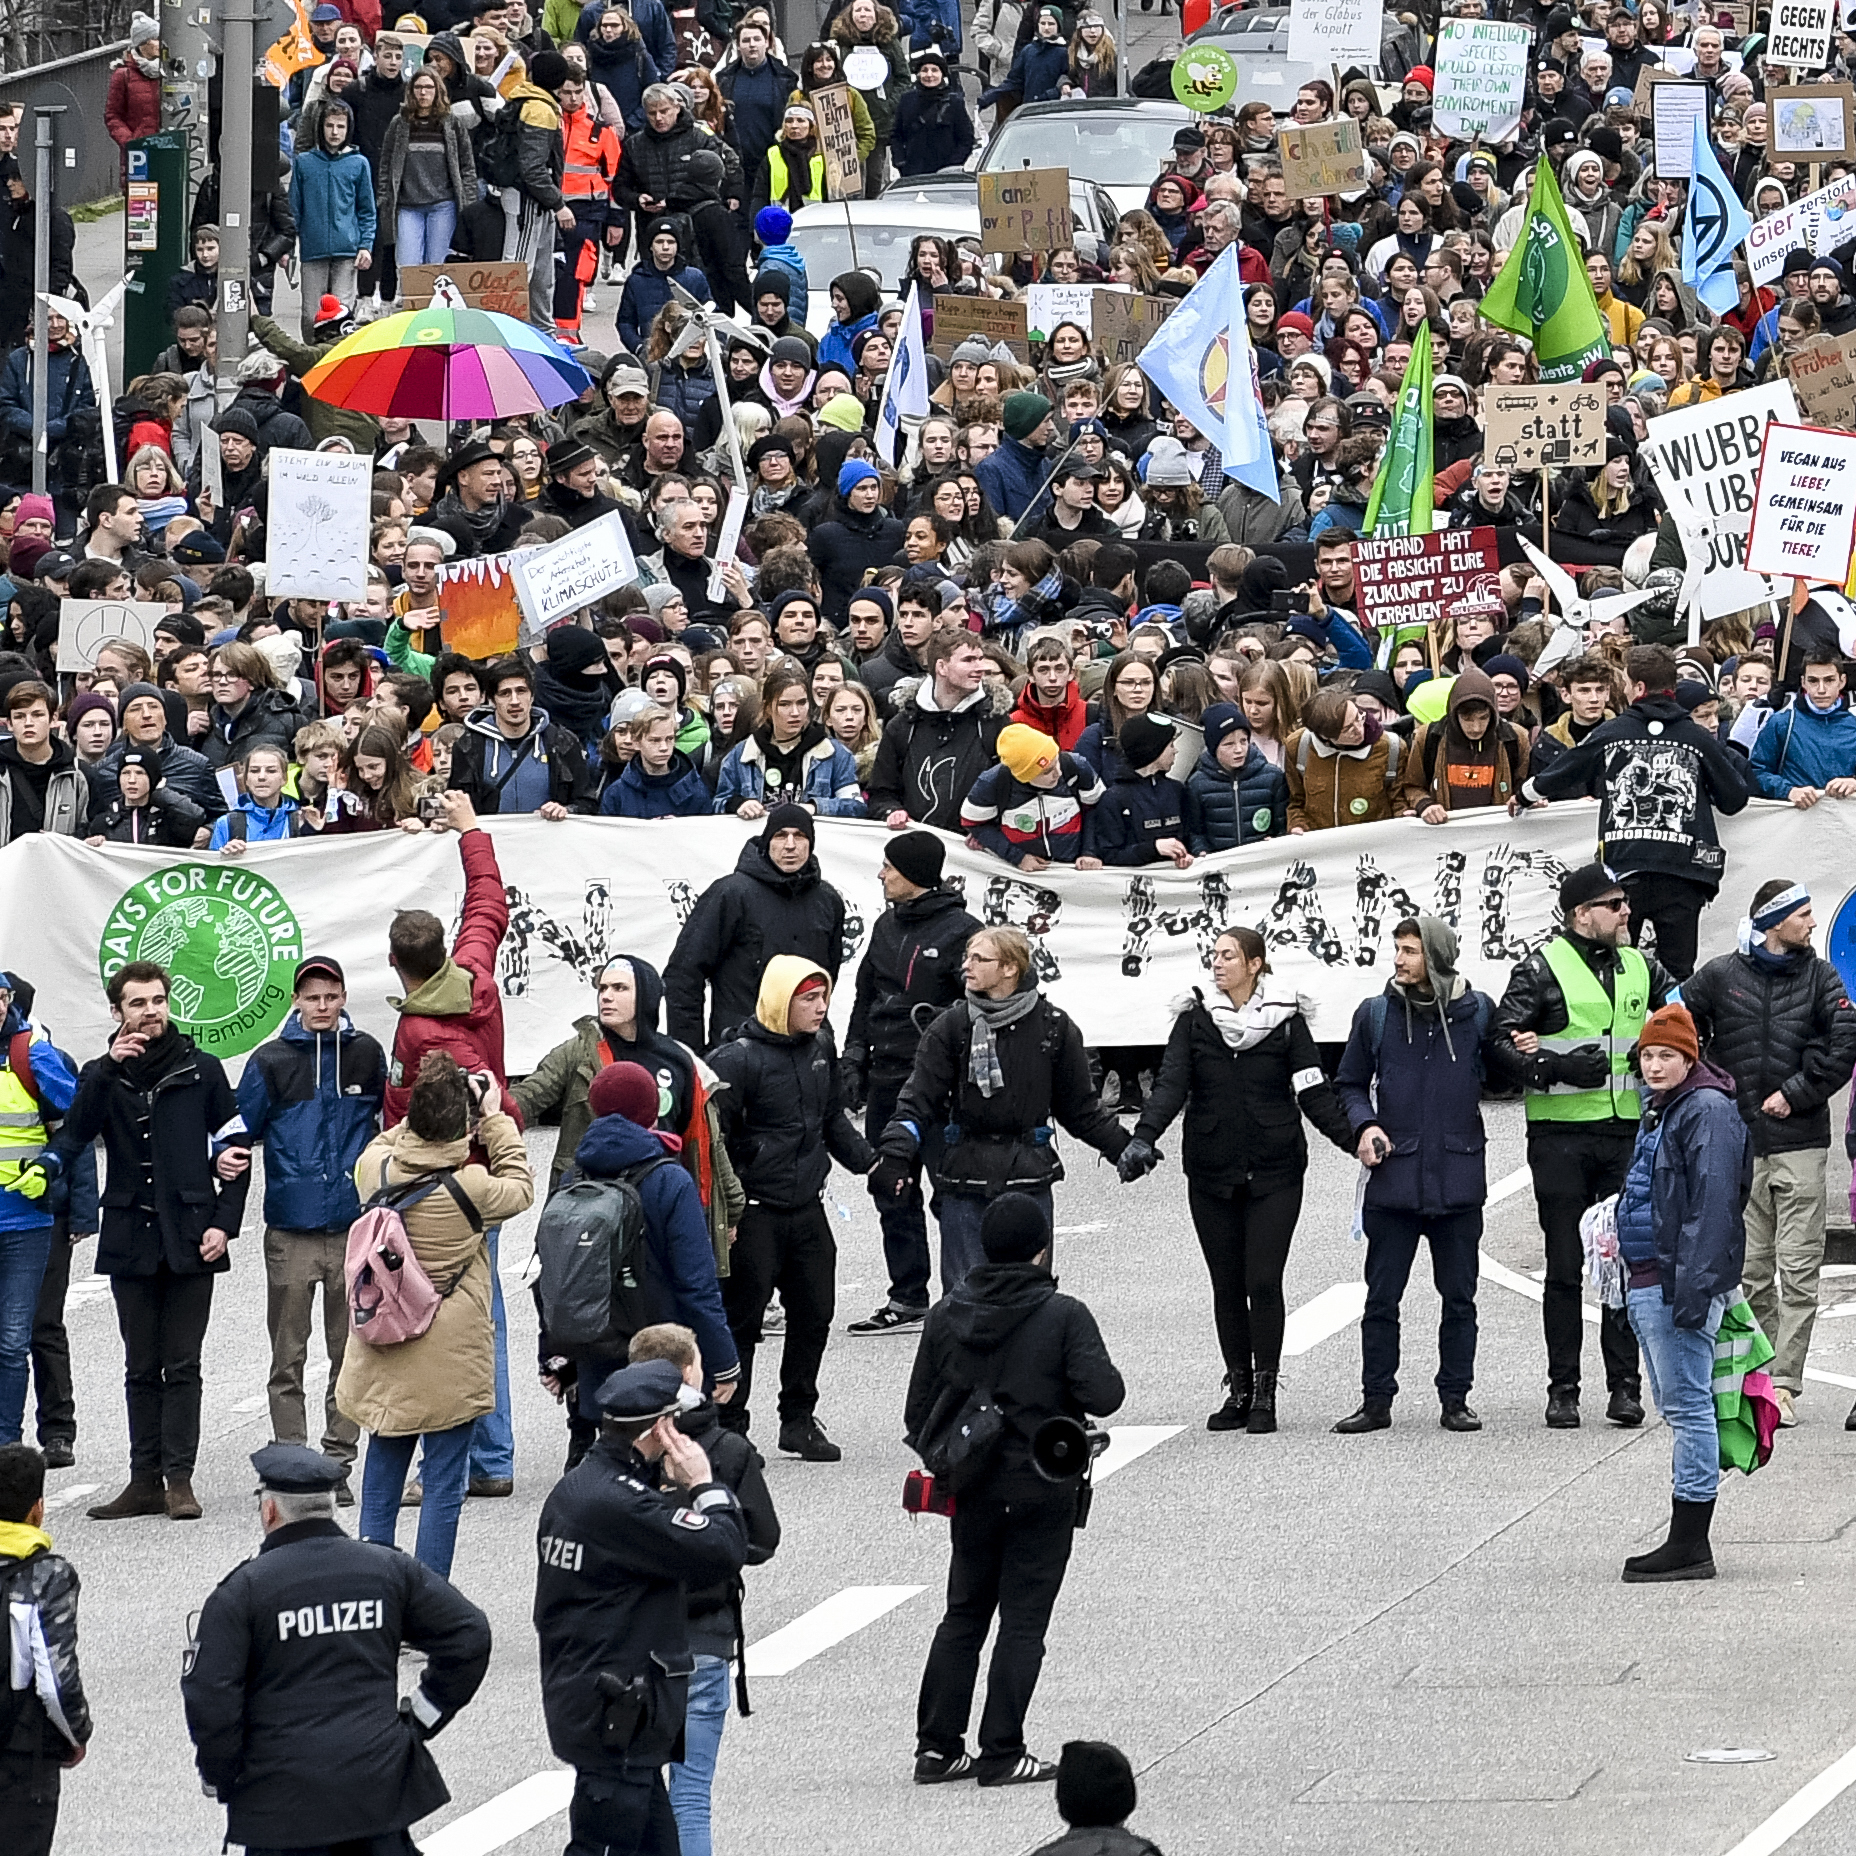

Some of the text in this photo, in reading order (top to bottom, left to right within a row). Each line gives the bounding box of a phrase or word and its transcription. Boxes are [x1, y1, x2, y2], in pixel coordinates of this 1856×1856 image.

[1302, 7, 1363, 21] der Globus
[1780, 5, 1827, 31] GEGEN
[1443, 25, 1466, 40] NO
[1459, 45, 1507, 61] SPECIES
[1771, 34, 1826, 61] RECHTS
[1437, 60, 1527, 77] WOULD DESTROY
[1449, 77, 1511, 94] THEIR OWN
[818, 92, 837, 112] THE
[1284, 129, 1308, 161] Ich
[128, 150, 146, 175] P
[842, 159, 858, 178] LEO
[1295, 158, 1365, 189] Schnee
[980, 175, 1041, 205] Planet
[1749, 211, 1794, 249] Gier
[1752, 239, 1798, 273] unsere
[1789, 349, 1844, 379] Früher
[1520, 414, 1583, 440] statt
[278, 454, 367, 472] STEHT BAUM
[1779, 450, 1846, 472] VEGAN AUS
[297, 473, 358, 486] WALD ALLEIN
[1790, 474, 1831, 492] LIEBE!
[1768, 494, 1844, 517] GEMEINSAM
[1779, 514, 1826, 536] FÜR DIE
[1439, 530, 1473, 550] HAT
[1781, 540, 1822, 559] TIERE!
[1360, 550, 1486, 582] DIE ABSICHT EURE
[541, 558, 622, 614] KLIMASCHUTZ
[1363, 576, 1464, 606] ZUKUNFT ZU
[1603, 830, 1694, 847] DISOBEDIENT
[148, 865, 301, 962] FOR FUTURE
[189, 982, 286, 1046] Hamburg
[278, 1599, 384, 1642] POLIZEI
